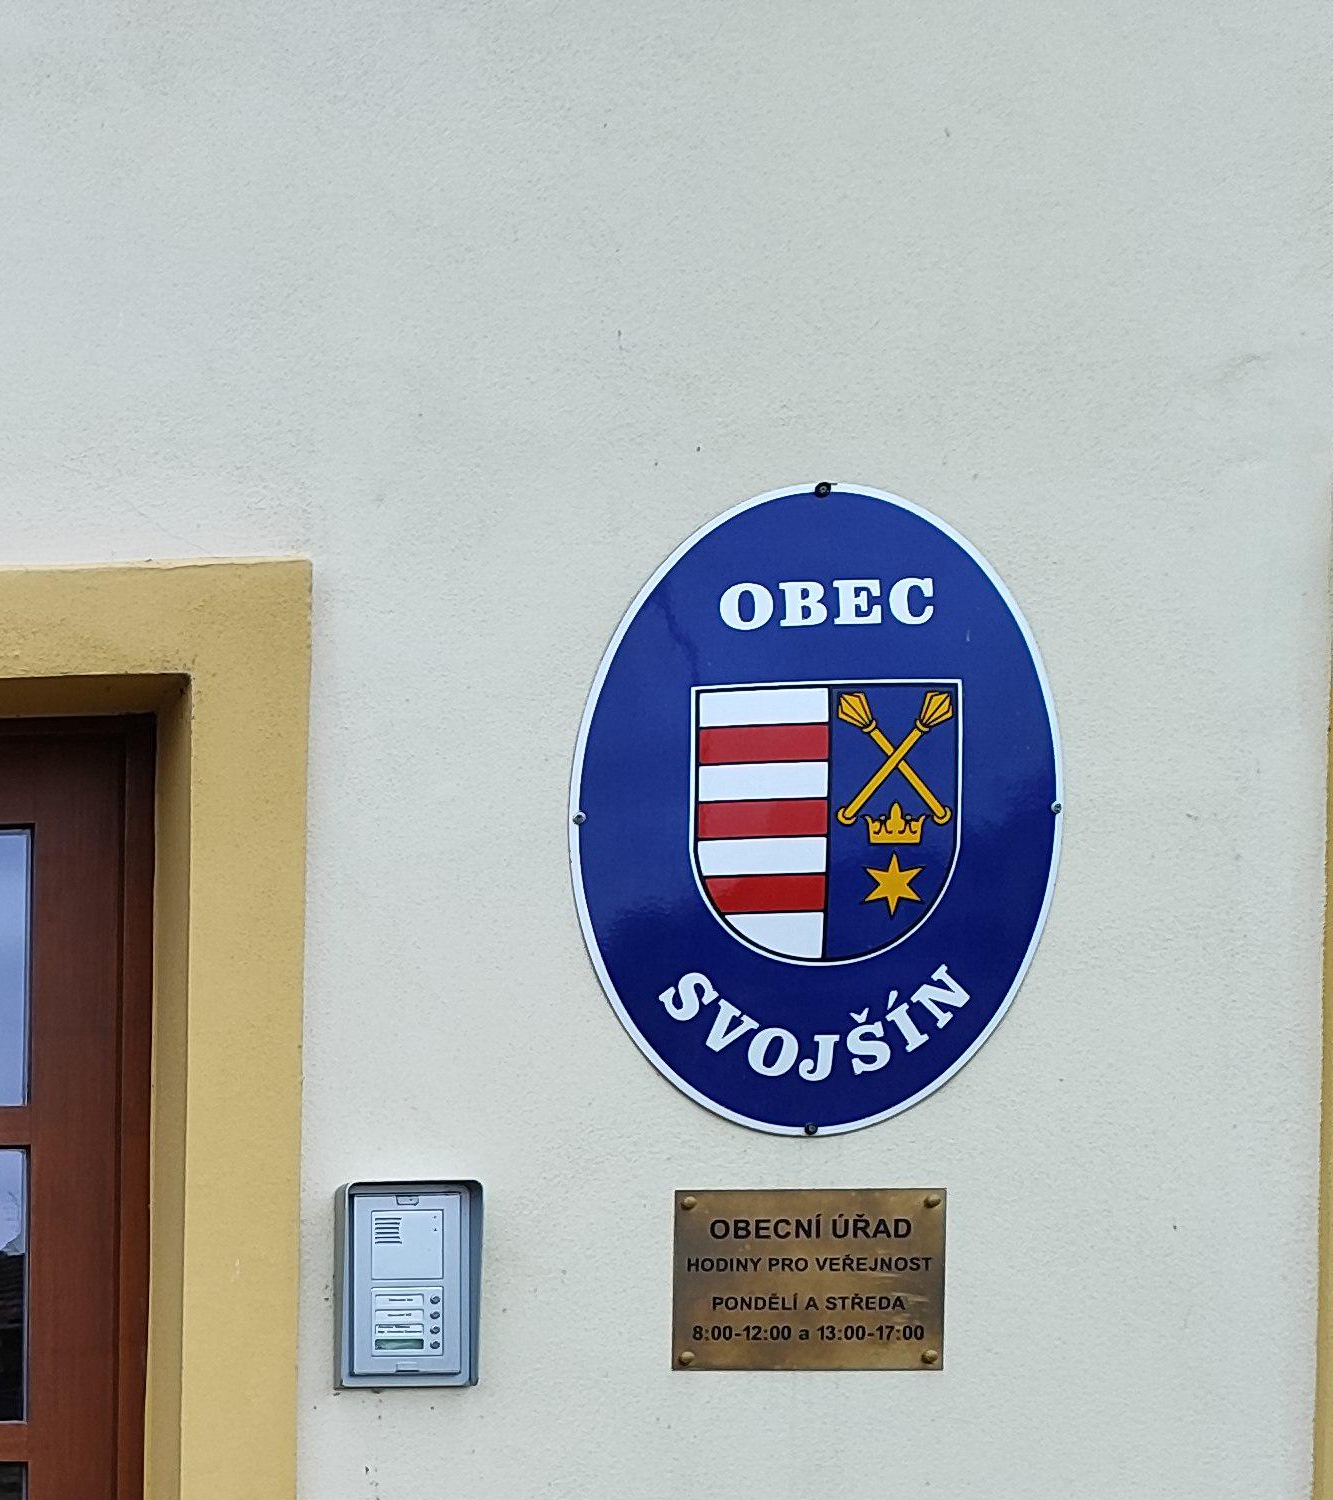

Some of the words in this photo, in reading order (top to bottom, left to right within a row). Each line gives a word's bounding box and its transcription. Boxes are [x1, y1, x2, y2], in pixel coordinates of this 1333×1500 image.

[718, 576, 935, 631] OBEC
[658, 964, 971, 1082] SVOJŠÍN
[709, 1214, 822, 1240] OBECNÍ
[831, 1213, 912, 1240] ÚŘAD
[687, 1257, 762, 1272] HODINY
[768, 1257, 809, 1272] PRO
[815, 1254, 933, 1272] VEŘEJNOST
[712, 1293, 798, 1311] PONDĚLÍ
[804, 1296, 819, 1311] A
[825, 1293, 906, 1311] STŘEDA
[692, 1325, 792, 1341] 8:00-12:00
[798, 1328, 810, 1341] a
[817, 1325, 925, 1341] 13:00-17:00
